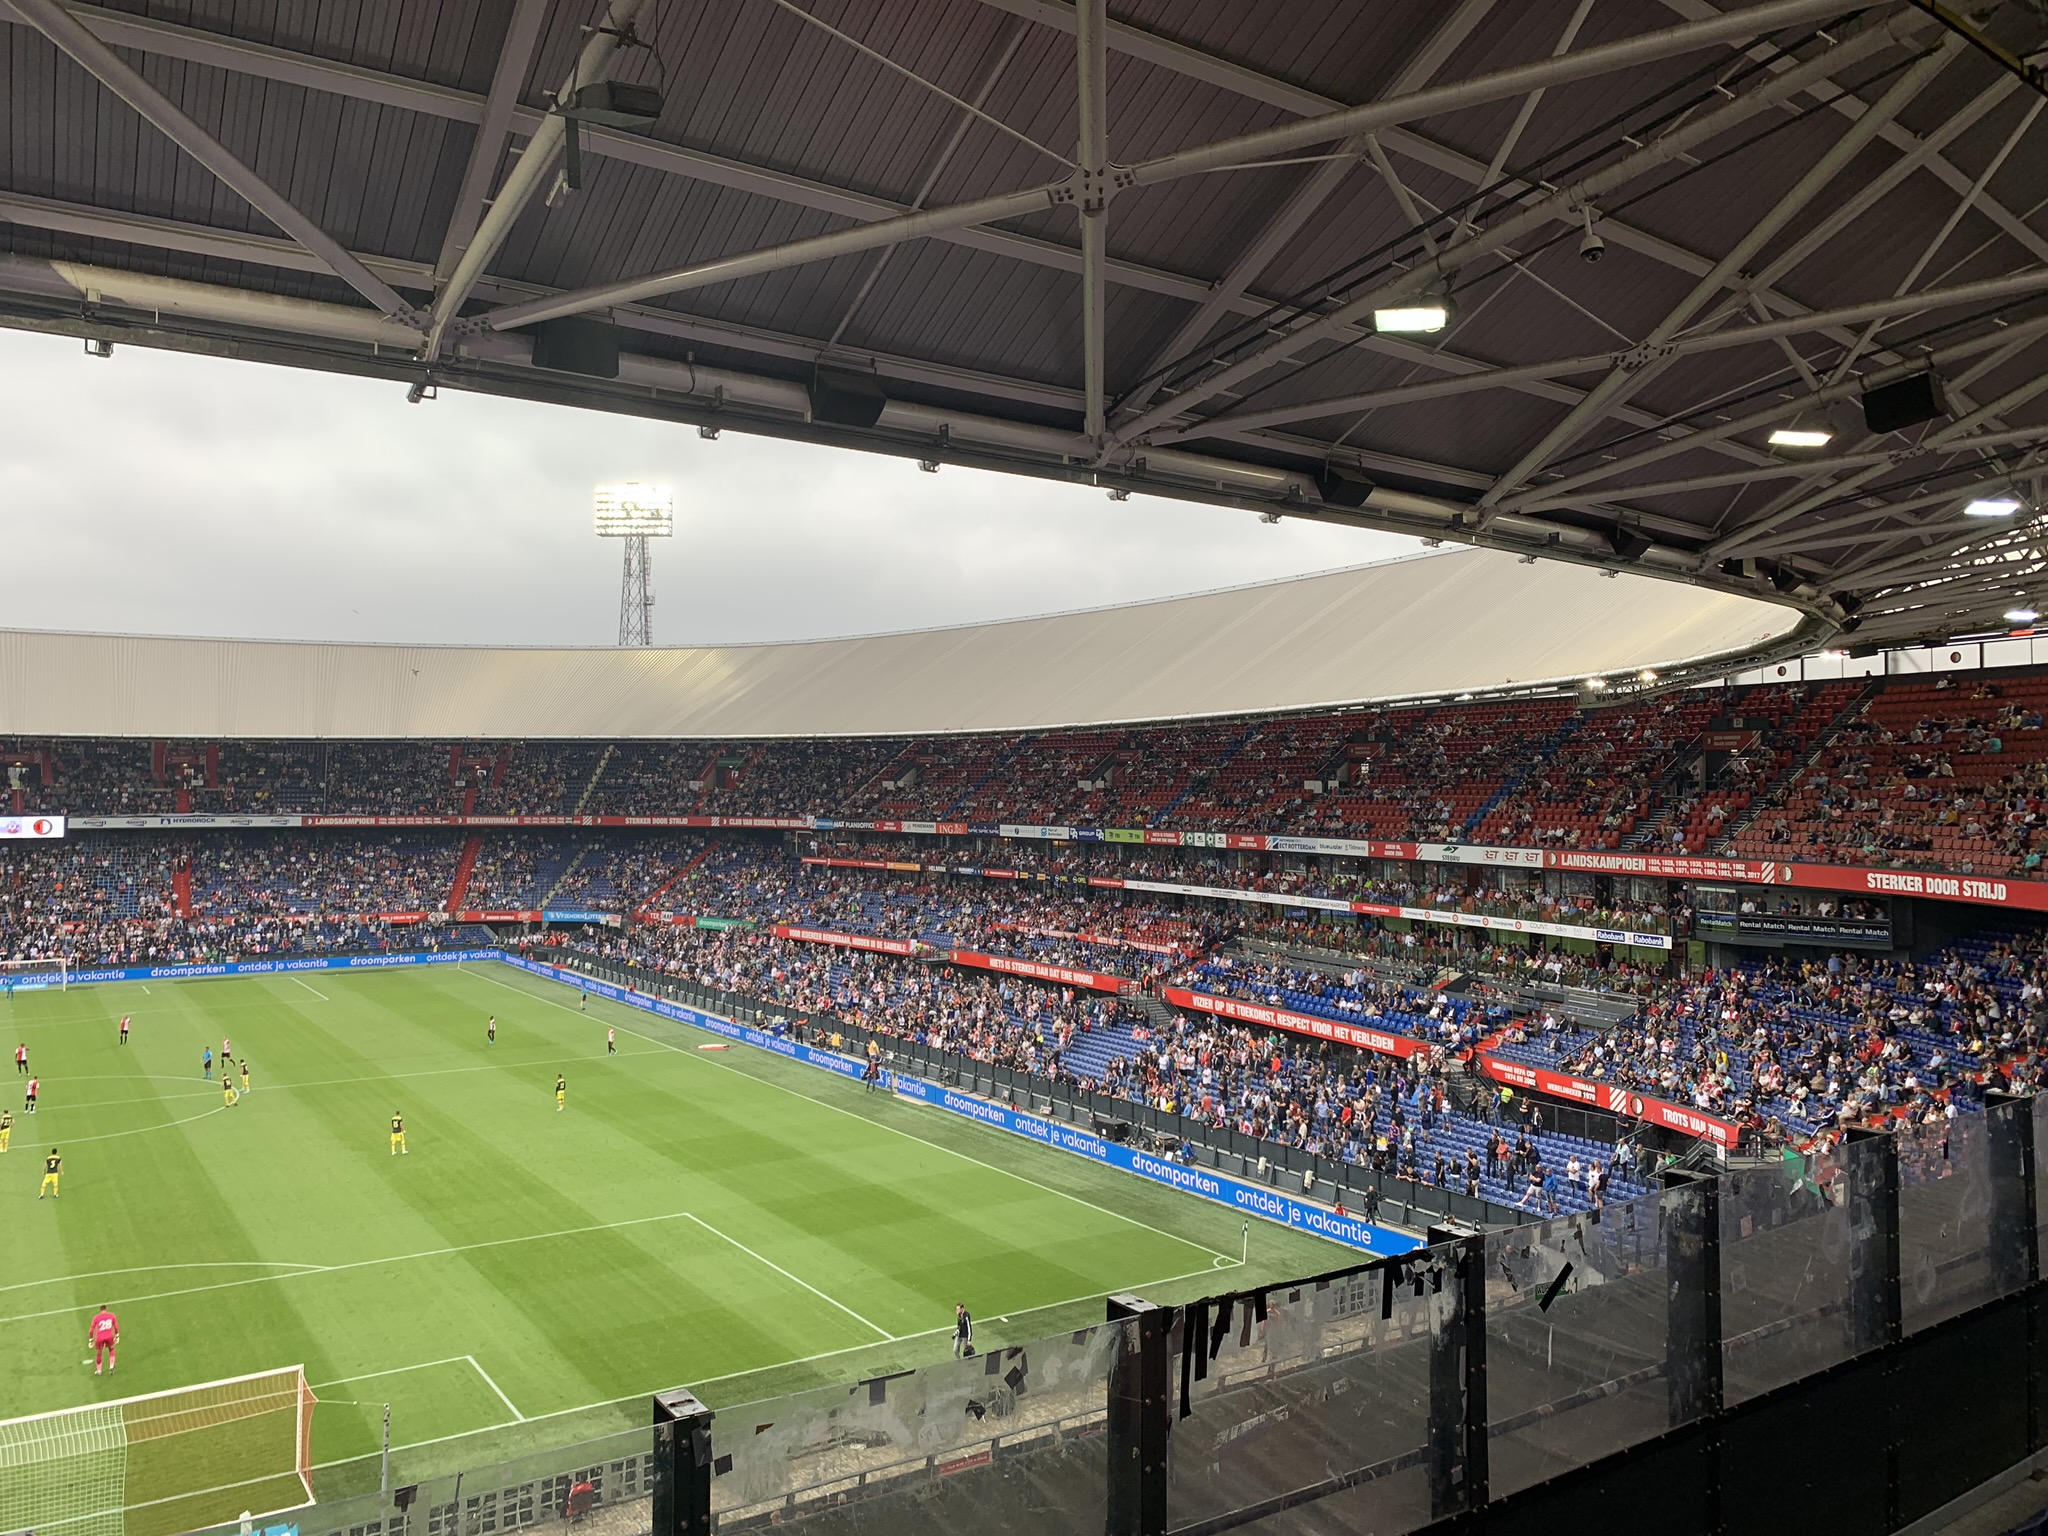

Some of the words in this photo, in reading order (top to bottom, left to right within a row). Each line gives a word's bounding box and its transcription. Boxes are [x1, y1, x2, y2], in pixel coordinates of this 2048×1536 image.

[315, 817, 375, 825] LANDSKAMPIOEN
[625, 817, 651, 825] STERKER
[729, 818, 742, 826] CLUB
[742, 818, 753, 826] VAN
[939, 824, 954, 834] ING
[1286, 842, 1316, 851] ROTTERDAM
[1319, 842, 1343, 850] bluewater
[1484, 850, 1499, 860] RET
[1504, 851, 1519, 861] RET
[1524, 852, 1540, 862] RET
[1561, 853, 1646, 871] LANDSKAMPIOEN
[1747, 871, 1761, 879] 2017
[1867, 873, 1923, 892] STERKER
[1925, 877, 1959, 896] DOOR
[1962, 880, 2007, 900] STRIJD
[1739, 921, 1762, 929] Rental
[1763, 921, 1785, 930] Match
[1787, 924, 1810, 932] Rental
[1813, 925, 1836, 933] Match
[1839, 926, 1863, 935] Rental
[1865, 928, 1889, 936] Match
[1597, 930, 1625, 942] Rabobank
[1634, 934, 1663, 947] Rabobank
[876, 938, 884, 948] DE
[350, 954, 416, 967] droomparken
[426, 951, 459, 962] ontdek
[150, 966, 226, 978] droomparken
[237, 961, 273, 972] ontdek
[274, 960, 284, 973] je
[286, 958, 329, 970] vakantie
[989, 958, 1005, 969] NIETS
[1005, 961, 1011, 970] IS
[1011, 962, 1035, 974] STERKER
[1036, 965, 1049, 977] DAN
[1049, 967, 1060, 979] DAT
[1061, 969, 1073, 980] ENE
[1073, 971, 1094, 985] WOORD
[21, 973, 62, 985] ontdek
[77, 969, 126, 981] vakantie
[559, 971, 582, 985] droomparken
[624, 991, 653, 1009] droomparken
[656, 1002, 671, 1014] ontdek
[671, 1007, 676, 1017] je
[676, 1009, 696, 1023] vakantie
[705, 1017, 741, 1037] droomparken
[1192, 995, 1214, 1010] VIZIER
[1215, 999, 1225, 1012] OP
[1226, 1002, 1236, 1014] DE
[1236, 1003, 1276, 1026] TOEKOMST,
[1276, 1013, 1310, 1031] RESPECT
[1310, 1020, 1333, 1037] VOOR
[1334, 1024, 1350, 1040] HET
[1351, 1027, 1394, 1051] VERLEDEN
[745, 1031, 764, 1045] ontdek
[764, 1036, 771, 1048] je
[771, 1038, 796, 1055] vakantie
[808, 1051, 853, 1074] droomparken
[1491, 1062, 1513, 1074] WINNAAR
[1513, 1065, 1526, 1076] UEFA
[1526, 1068, 1536, 1078] CUP
[884, 1071, 891, 1088] je
[1504, 1072, 1516, 1082] 1974
[1516, 1075, 1524, 1084] EN
[898, 1078, 926, 1097] akantie
[1546, 1082, 1583, 1099] WERELDBEKER
[1571, 1081, 1596, 1094] WINNAAR
[944, 1091, 1005, 1124] droomparken
[1662, 1107, 1689, 1128] TROTS
[1689, 1116, 1706, 1133] VAN
[1015, 1117, 1049, 1139] ontdek
[1049, 1125, 1060, 1144] je
[1062, 1132, 1106, 1157] vakantie
[1132, 1152, 1219, 1195] droomparken
[1235, 1187, 1284, 1217] ontdek
[1287, 1201, 1301, 1223] je
[1304, 1210, 1372, 1245] vakantie
[98, 1318, 112, 1331] 28
